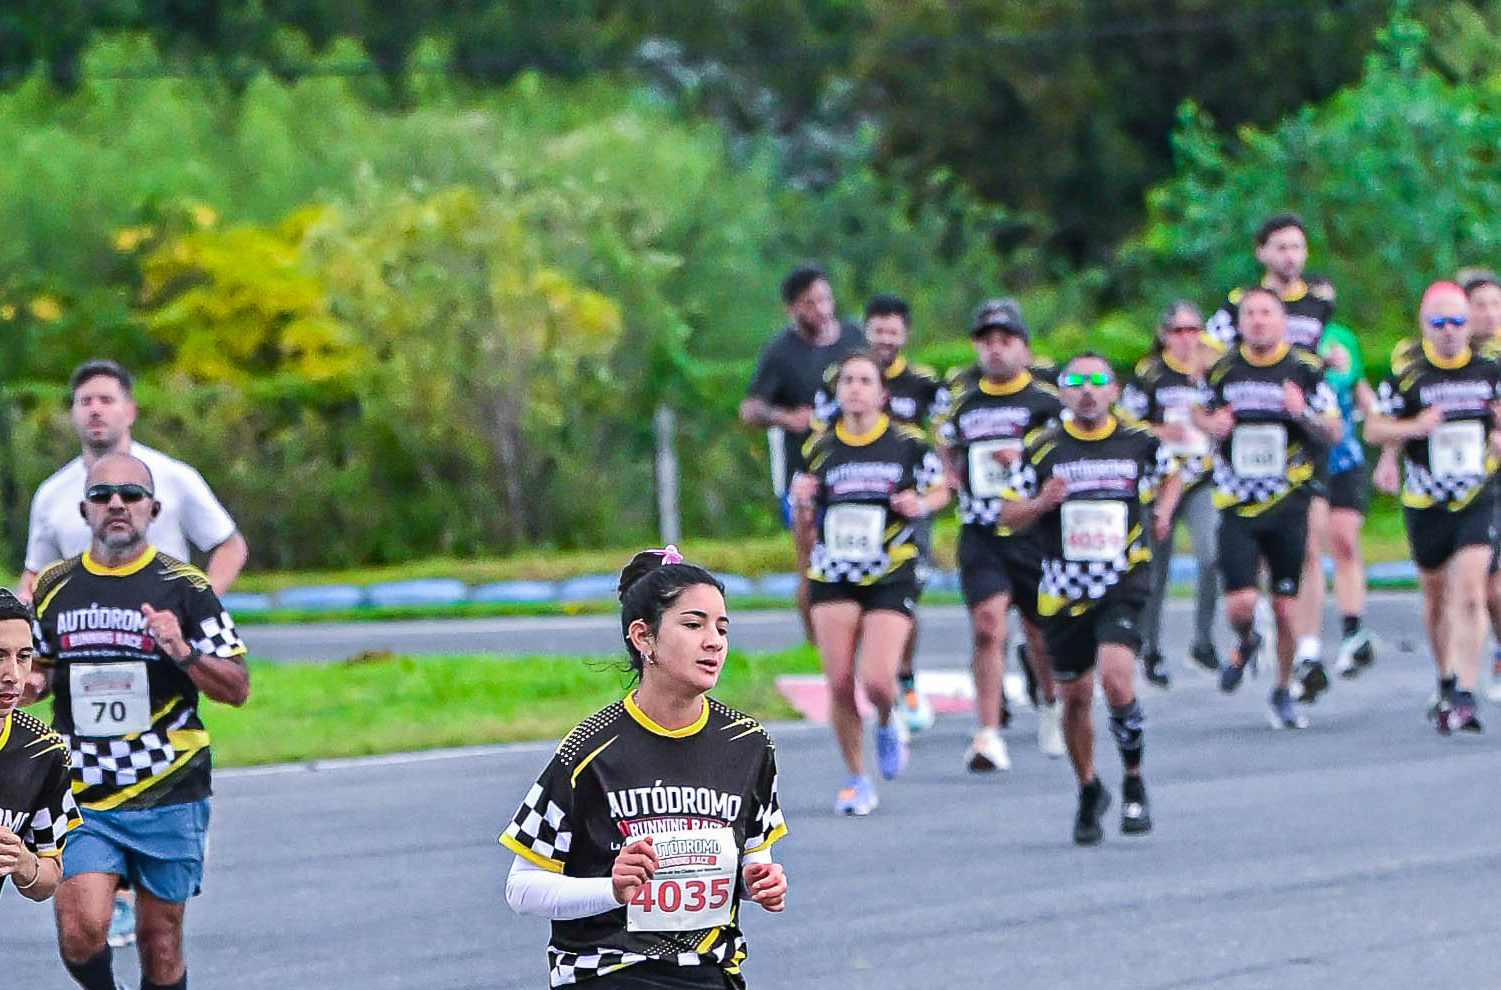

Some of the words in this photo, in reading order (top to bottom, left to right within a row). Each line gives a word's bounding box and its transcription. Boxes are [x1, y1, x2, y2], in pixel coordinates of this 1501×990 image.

[57, 602, 154, 636] AUTÓDROM
[91, 701, 126, 723] 70
[607, 780, 742, 821] AUTÓDROMO
[629, 819, 689, 837] RUNNING
[655, 837, 721, 857] UTÓDROMO
[630, 878, 730, 912] 4035
